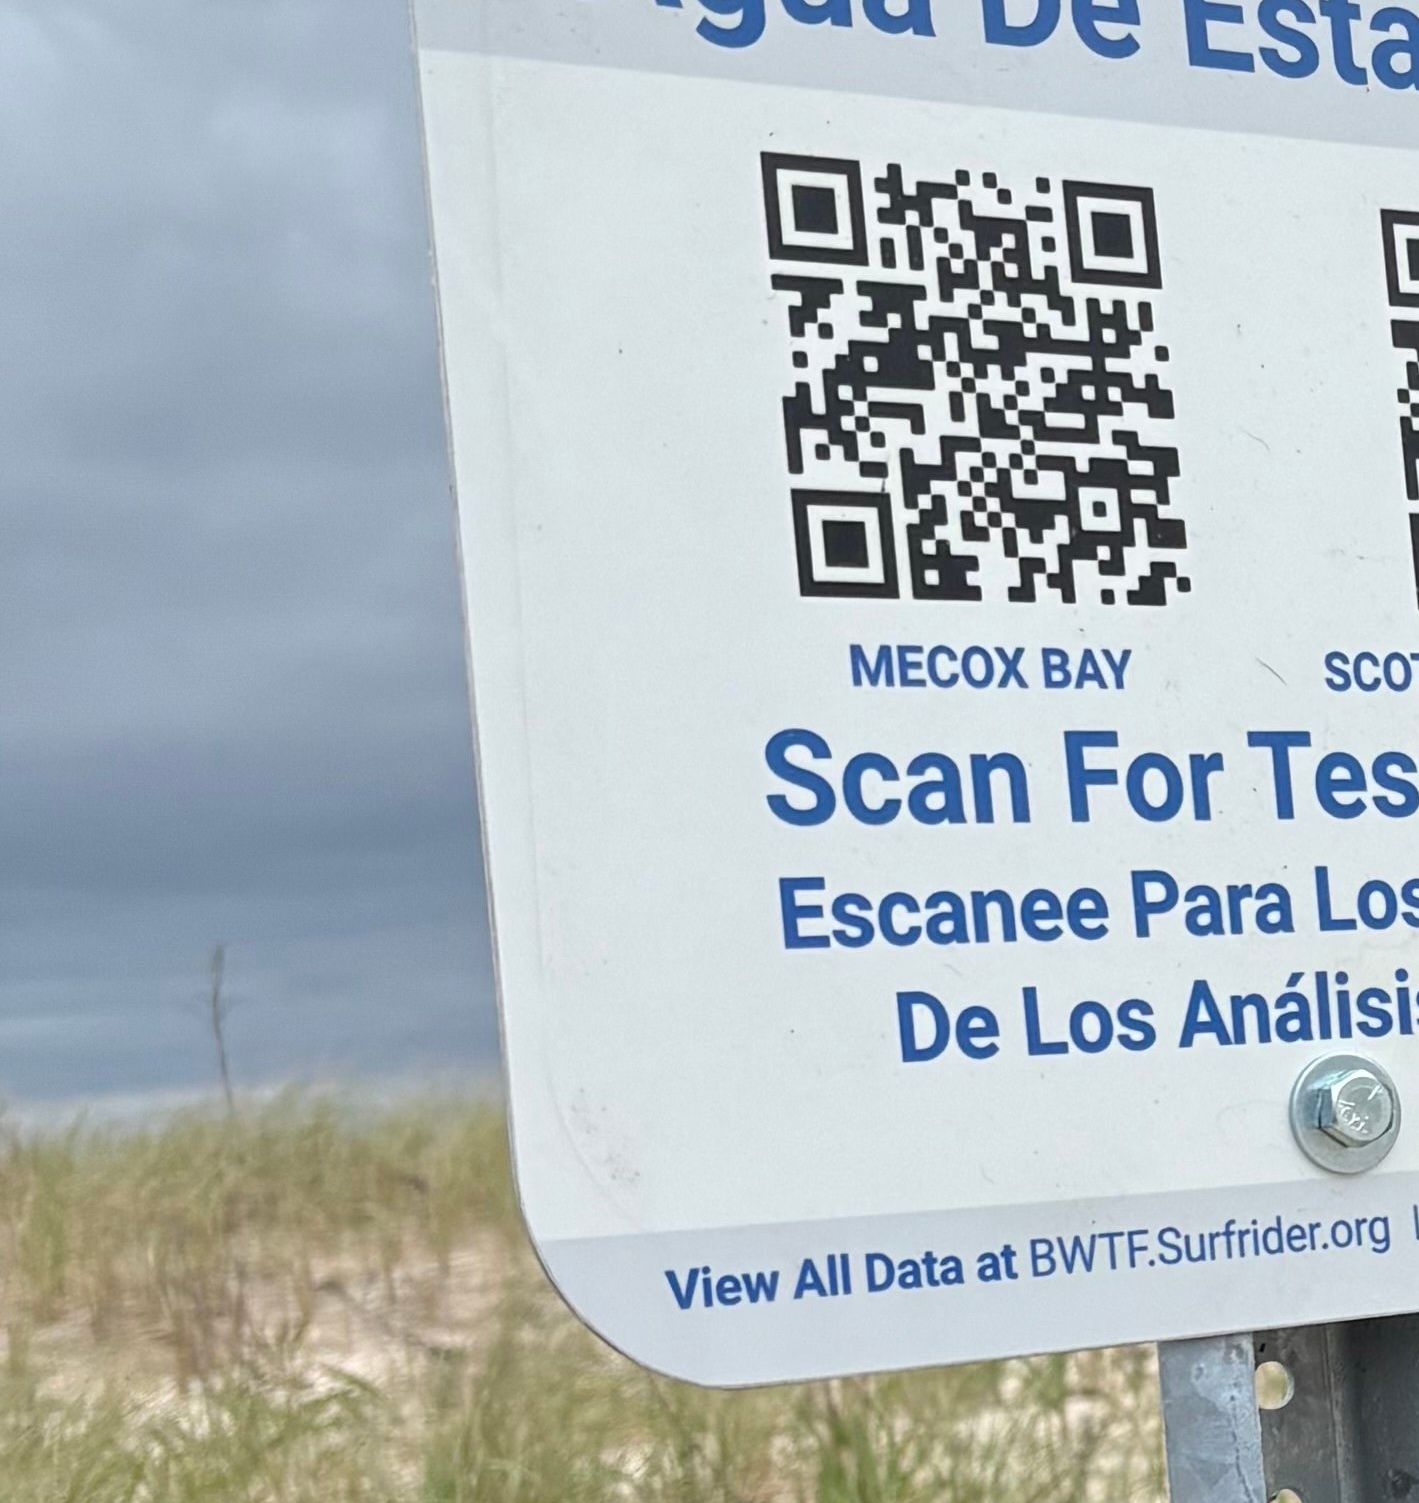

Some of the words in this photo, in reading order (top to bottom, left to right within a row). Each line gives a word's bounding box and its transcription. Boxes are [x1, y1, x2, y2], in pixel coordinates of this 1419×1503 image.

[850, 645, 1025, 688] MECOX
[1042, 648, 1130, 689] BAY
[765, 729, 1030, 826] Scan
[1064, 731, 1223, 822] For
[779, 877, 1108, 949] Escanee
[1131, 870, 1292, 938] Para
[896, 991, 999, 1062] De
[1023, 987, 1156, 1056] Los
[665, 1267, 779, 1310] View
[794, 1254, 851, 1298] All
[865, 1252, 964, 1292] Data
[977, 1245, 1016, 1282] at
[1030, 1217, 1390, 1277] BWTF.Surfrider.org
